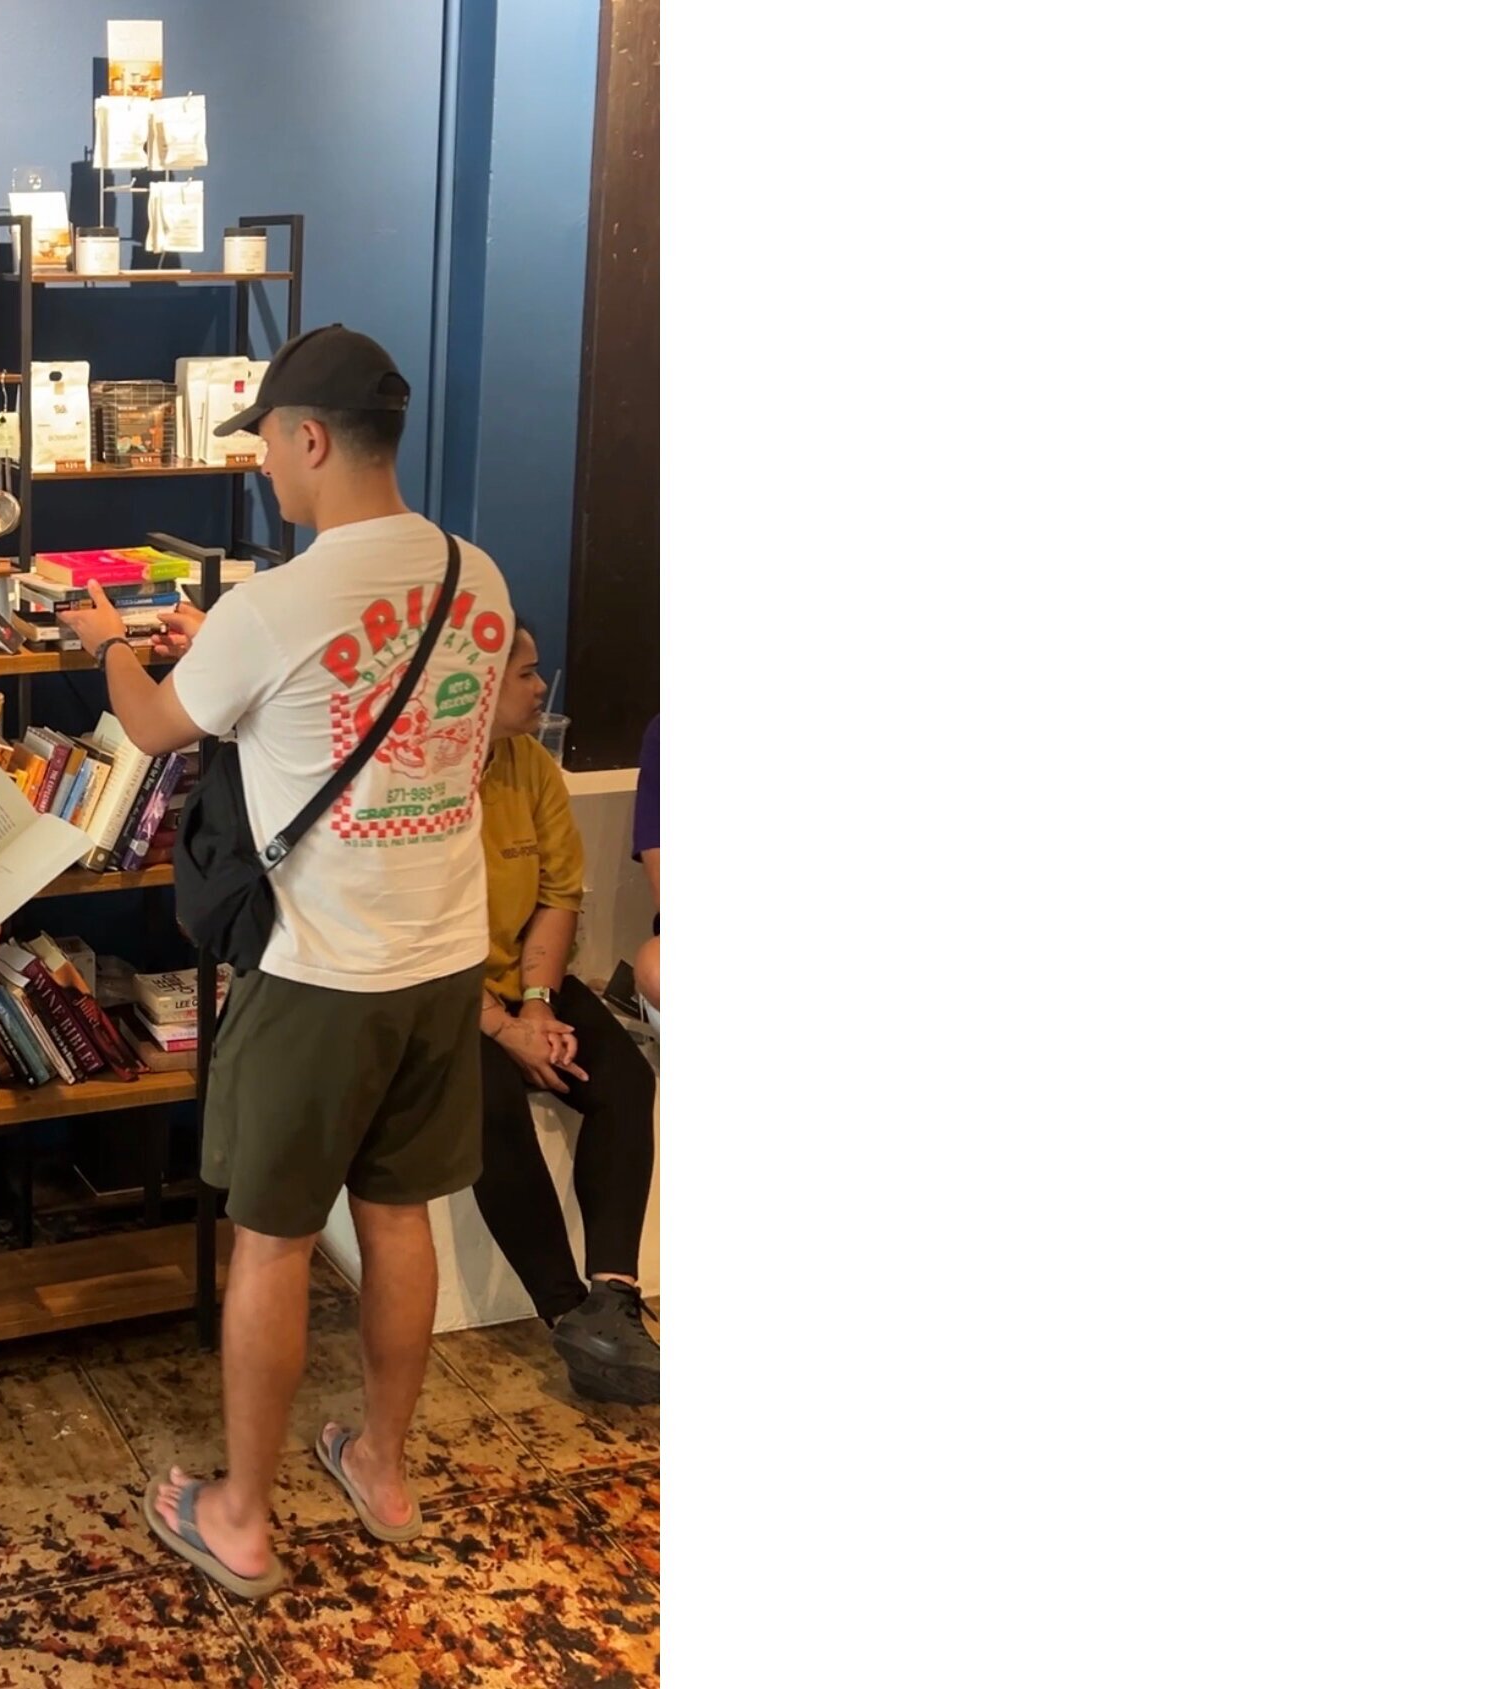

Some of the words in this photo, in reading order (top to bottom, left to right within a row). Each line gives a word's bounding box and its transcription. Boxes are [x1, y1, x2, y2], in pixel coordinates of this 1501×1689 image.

[356, 804, 423, 820] CRAFTED
[175, 1000, 190, 1009] LEE
[32, 972, 66, 1020] WINE
[57, 1016, 96, 1066] BIBLE
